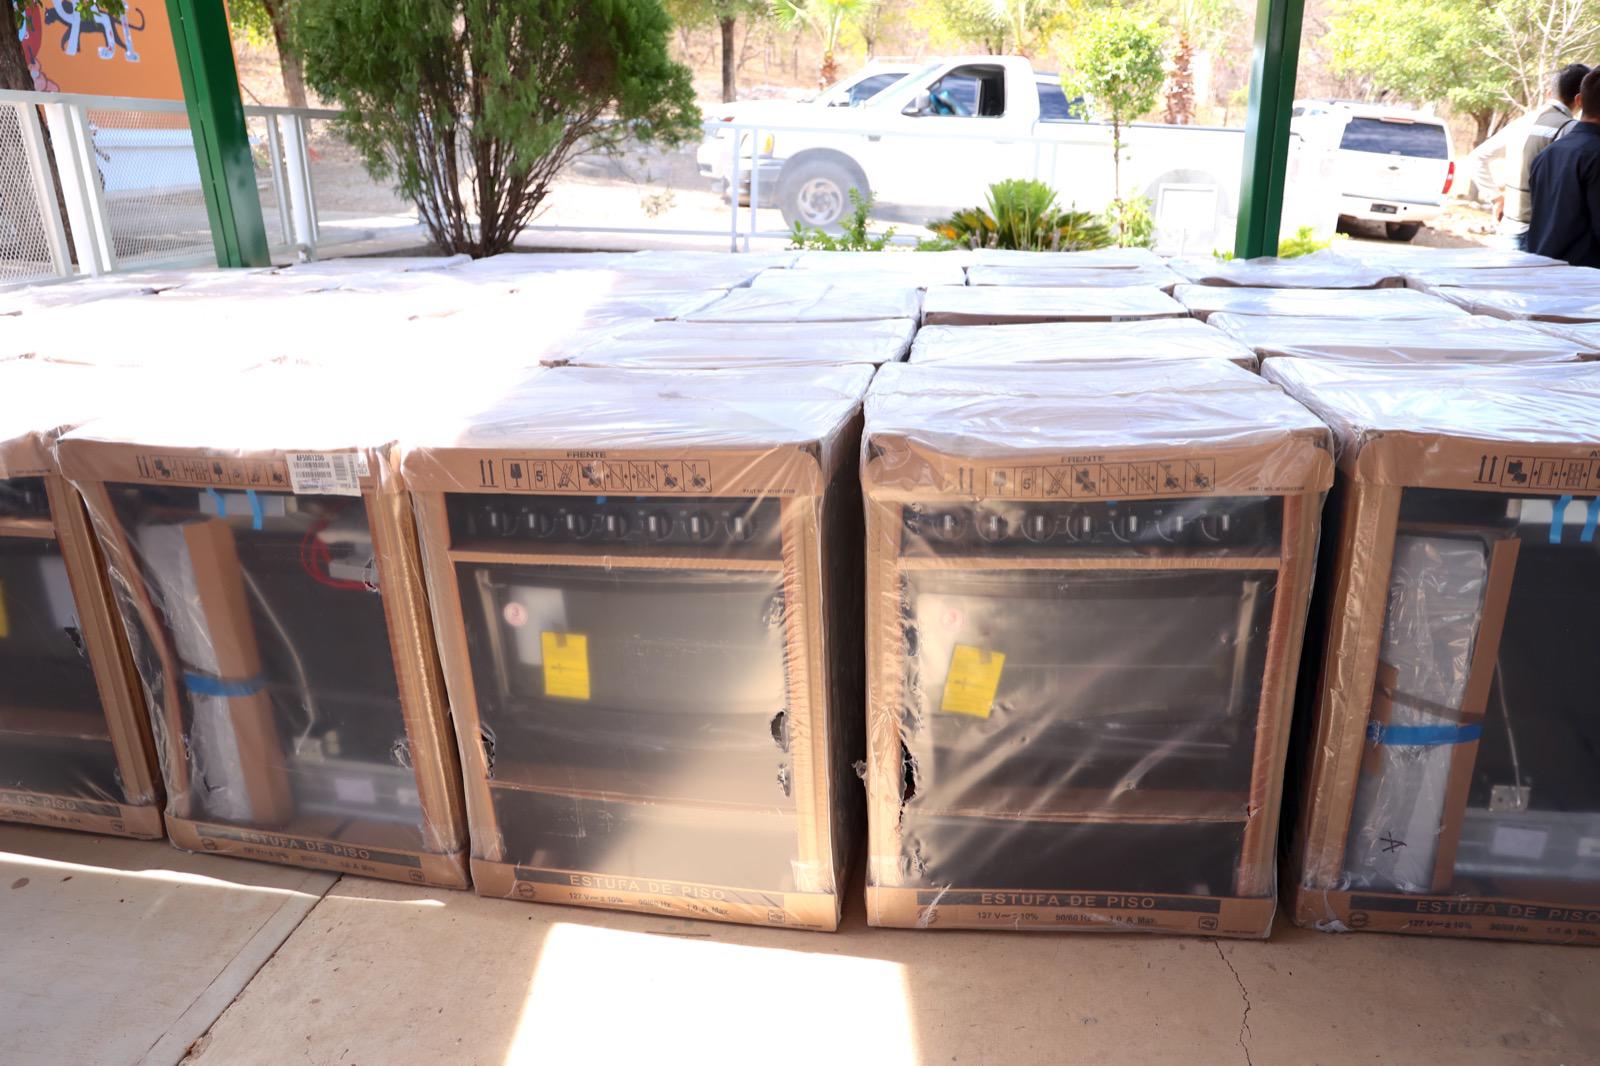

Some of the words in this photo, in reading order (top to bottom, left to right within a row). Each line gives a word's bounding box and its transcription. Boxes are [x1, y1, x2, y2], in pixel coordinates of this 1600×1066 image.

[566, 450, 607, 459] FRENTE
[1060, 455, 1105, 463] FRENTE
[535, 470, 544, 482] 5
[1022, 478, 1032, 490] 5
[240, 831, 299, 850] ESTUFA
[306, 841, 327, 852] DE
[333, 845, 370, 860] PISO
[569, 874, 641, 892] ESTUFA
[648, 883, 673, 895] DE
[682, 886, 726, 900] PISO
[980, 893, 1061, 907] ESTUFA
[1070, 895, 1097, 907] DE
[1106, 896, 1155, 909] PISO
[1416, 900, 1497, 915] ESTUFA
[1508, 904, 1537, 918] DE
[1548, 909, 1600, 922] PISO
